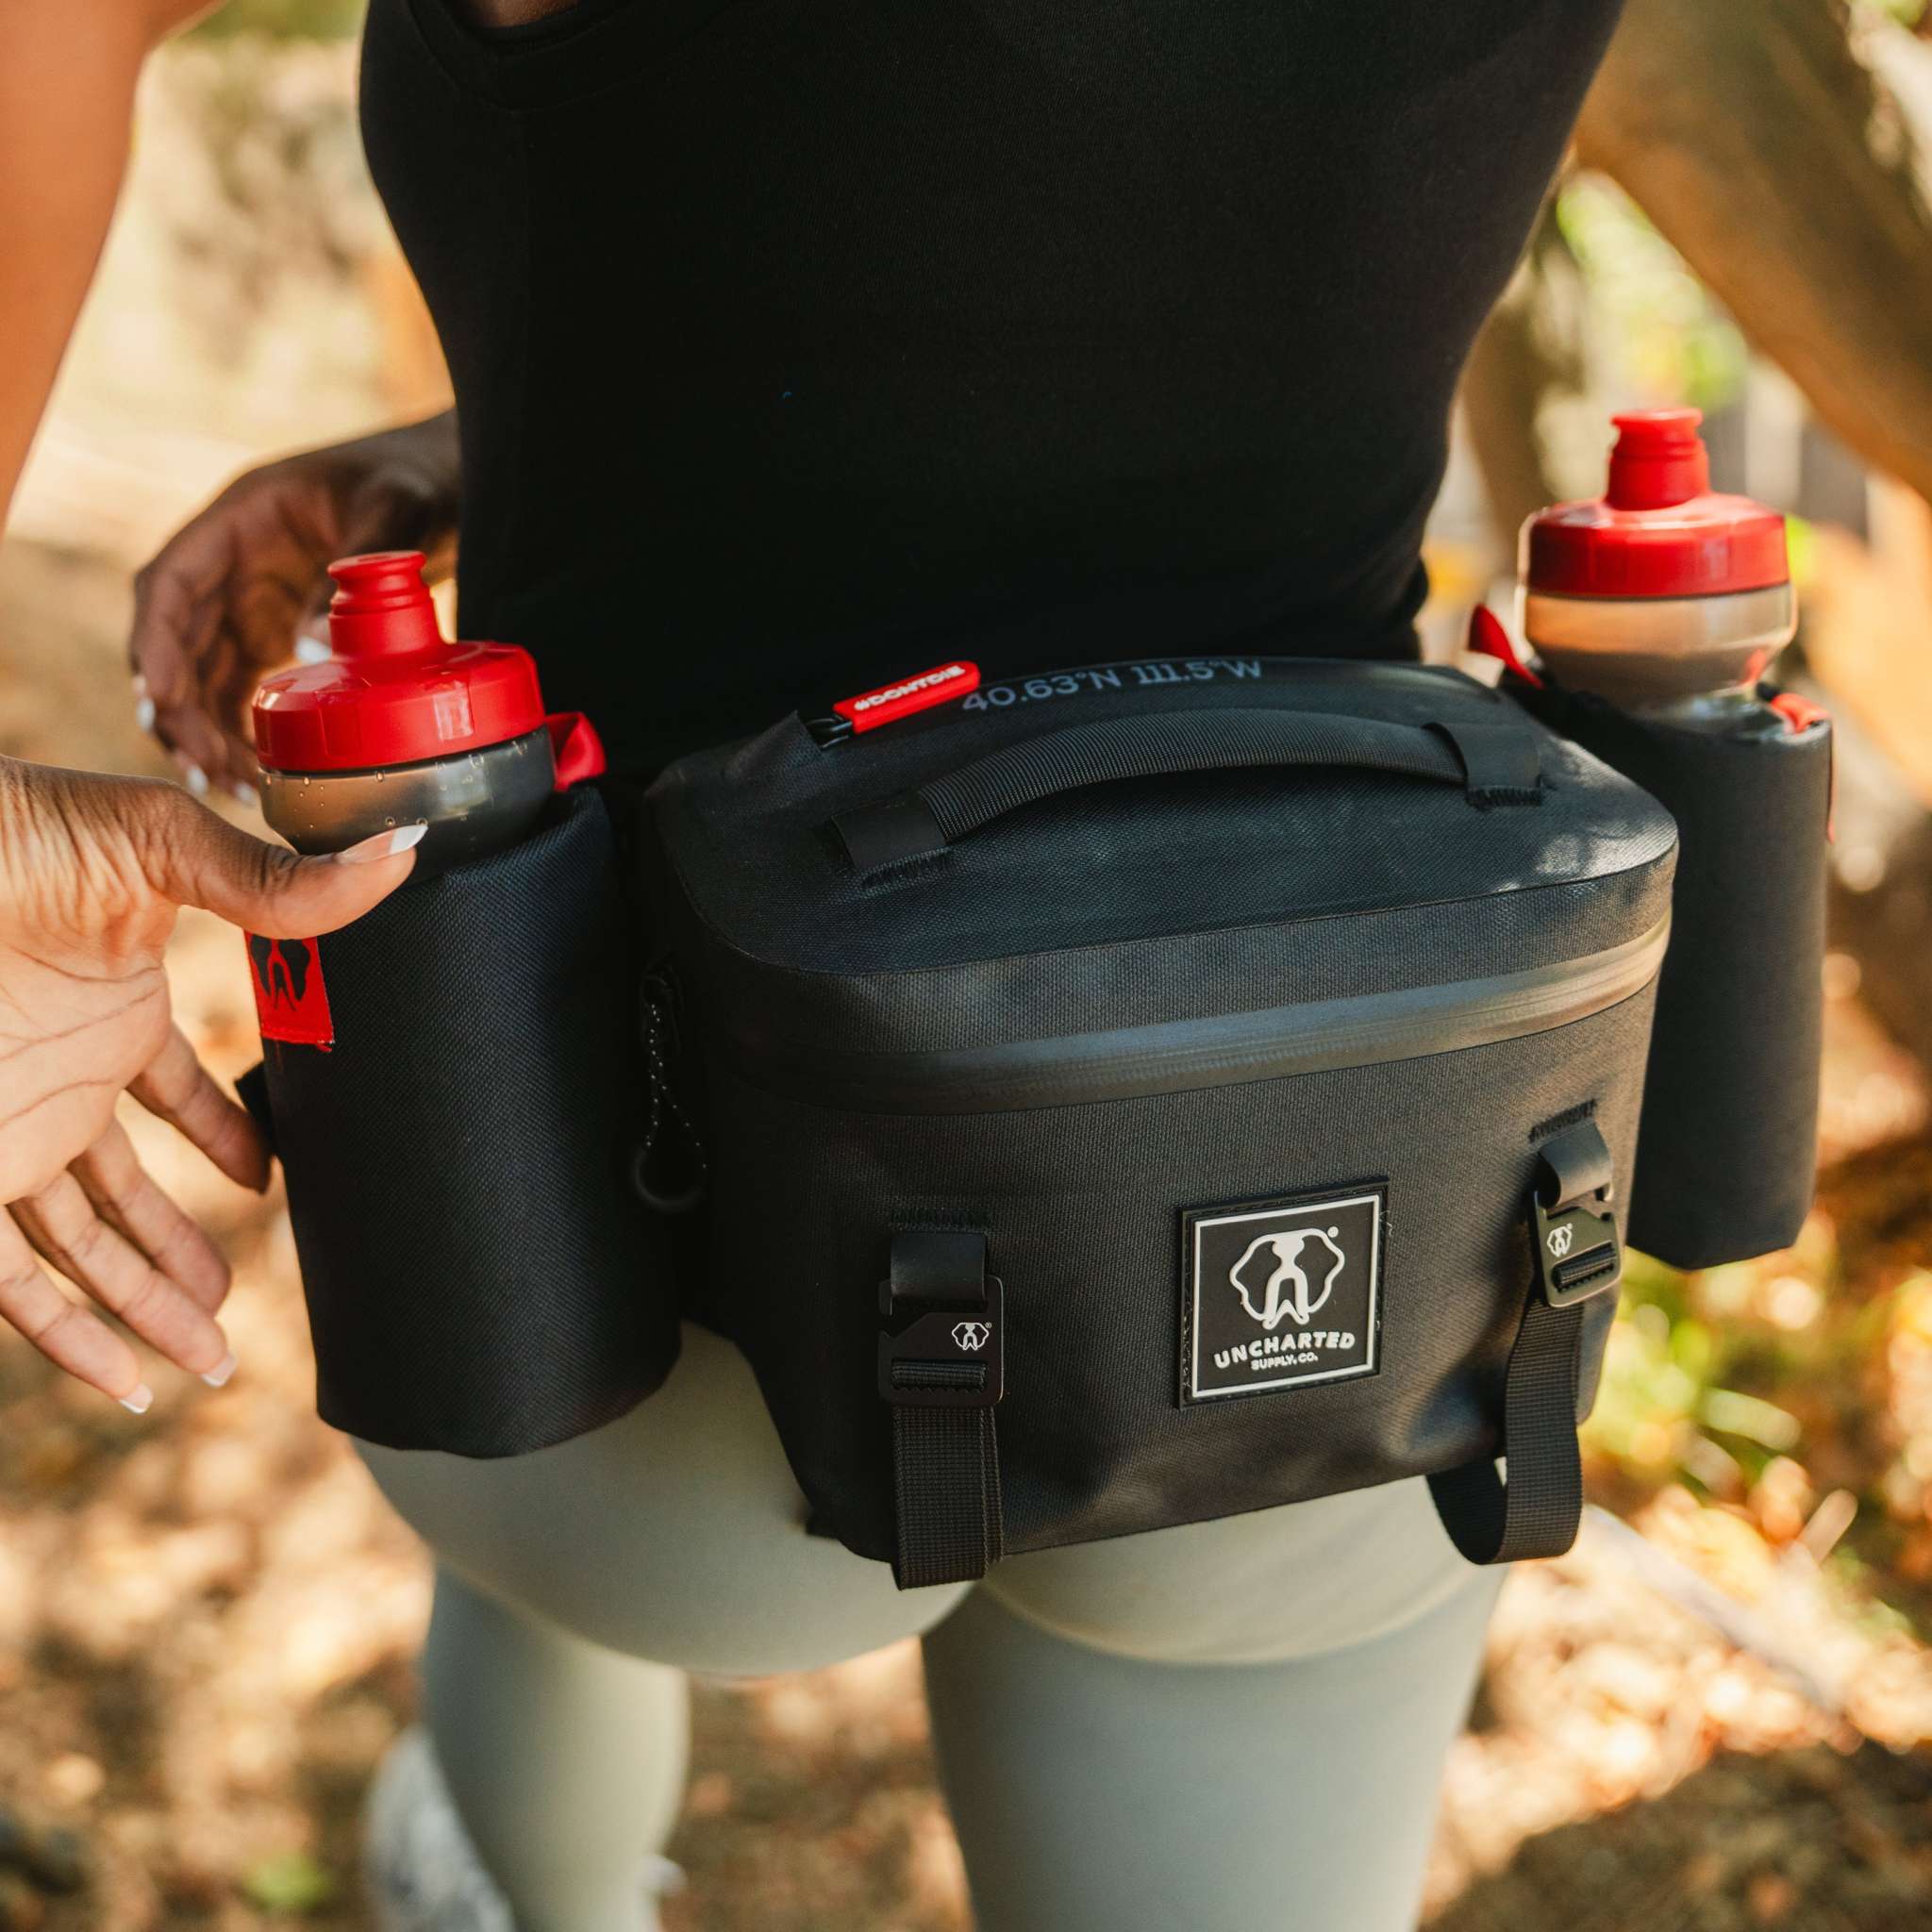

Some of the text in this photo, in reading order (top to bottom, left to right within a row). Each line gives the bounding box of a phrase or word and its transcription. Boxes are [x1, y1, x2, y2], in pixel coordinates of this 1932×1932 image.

[961, 658, 1262, 710] 40.63°N 111.5°W
[1213, 1331, 1356, 1369] UNCHARTED
